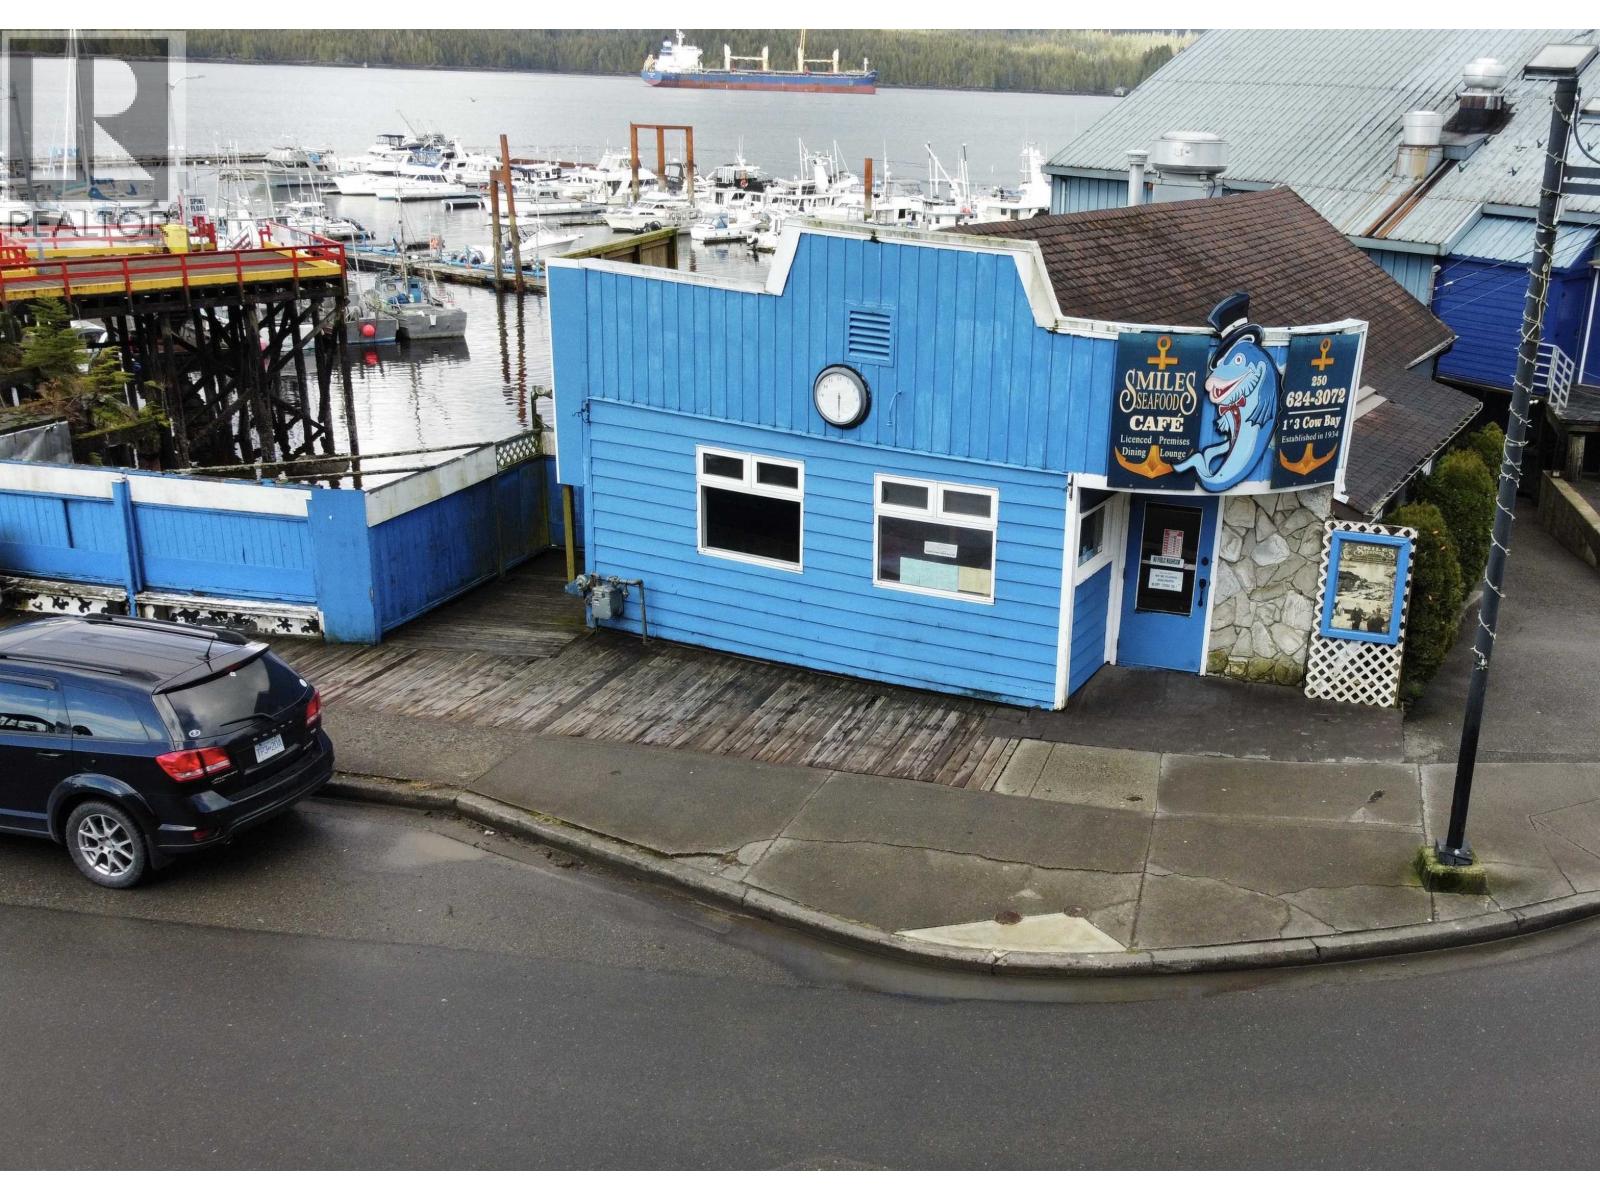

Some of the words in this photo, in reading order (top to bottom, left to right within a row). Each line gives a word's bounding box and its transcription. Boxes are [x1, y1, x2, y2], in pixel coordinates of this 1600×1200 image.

[1311, 375, 1328, 387] 250
[1119, 368, 1197, 415] SMILES
[1285, 387, 1346, 408] 624-3072
[1129, 413, 1185, 433] CAFÉ
[1302, 416, 1322, 429] Cow
[1323, 414, 1341, 429] Bay
[1120, 434, 1152, 445] Licenced
[1159, 435, 1190, 446] Premises
[1281, 433, 1317, 443] Established
[1324, 430, 1339, 439] 1934
[1122, 446, 1146, 459] Dining
[1160, 448, 1187, 460] Lounge
